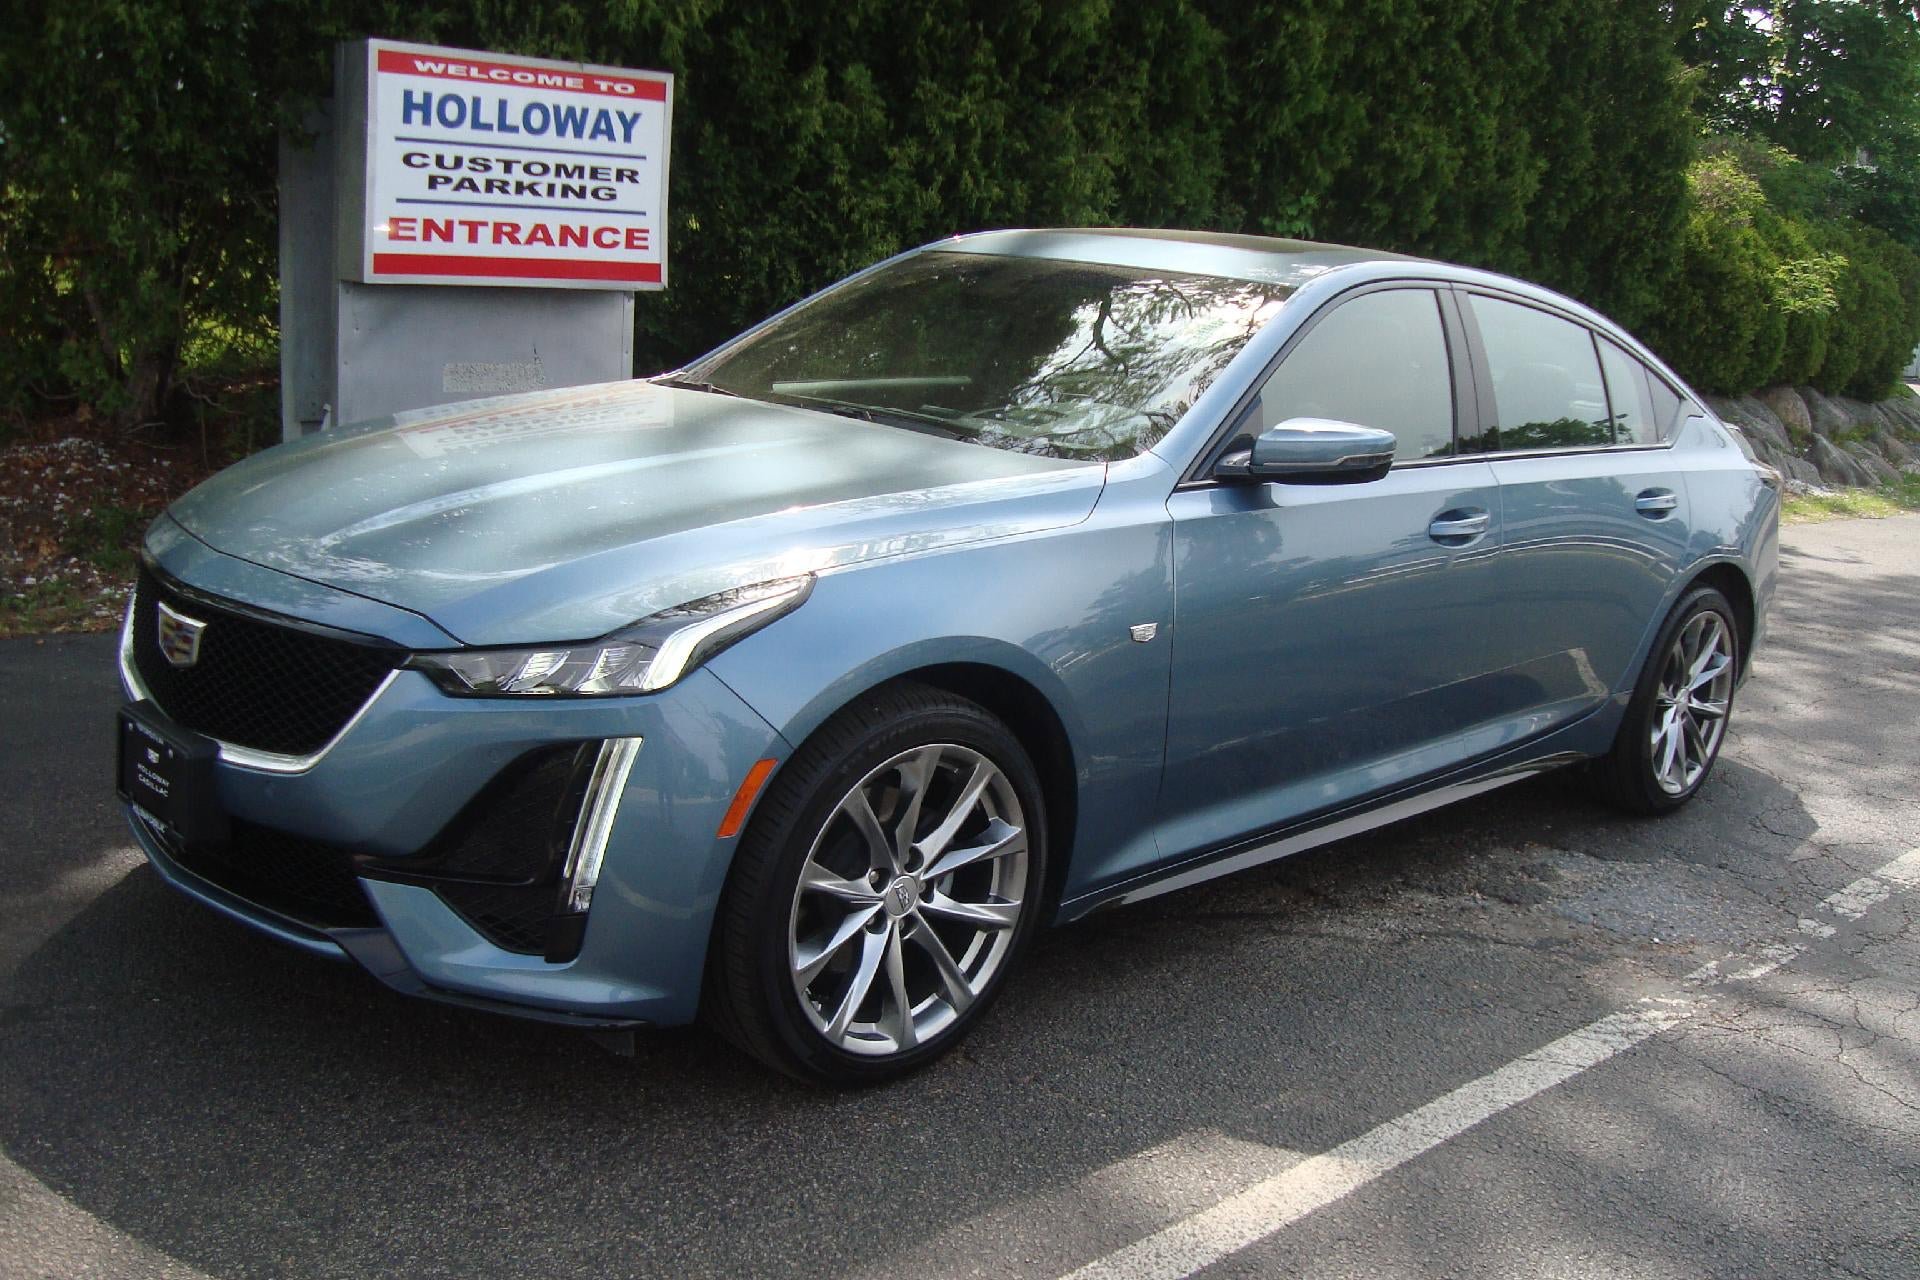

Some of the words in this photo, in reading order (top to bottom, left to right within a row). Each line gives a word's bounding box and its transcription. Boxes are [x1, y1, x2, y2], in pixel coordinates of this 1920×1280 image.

[414, 60, 584, 89] WELCOME
[594, 79, 635, 94] TO
[402, 88, 642, 143] HOLLOWAY
[402, 152, 640, 184] CUSTOMER
[427, 175, 618, 201] PARKING
[388, 216, 650, 250] ENTRANCE
[138, 763, 170, 787] HOLLOWAY
[138, 774, 169, 797] CADILLAC
